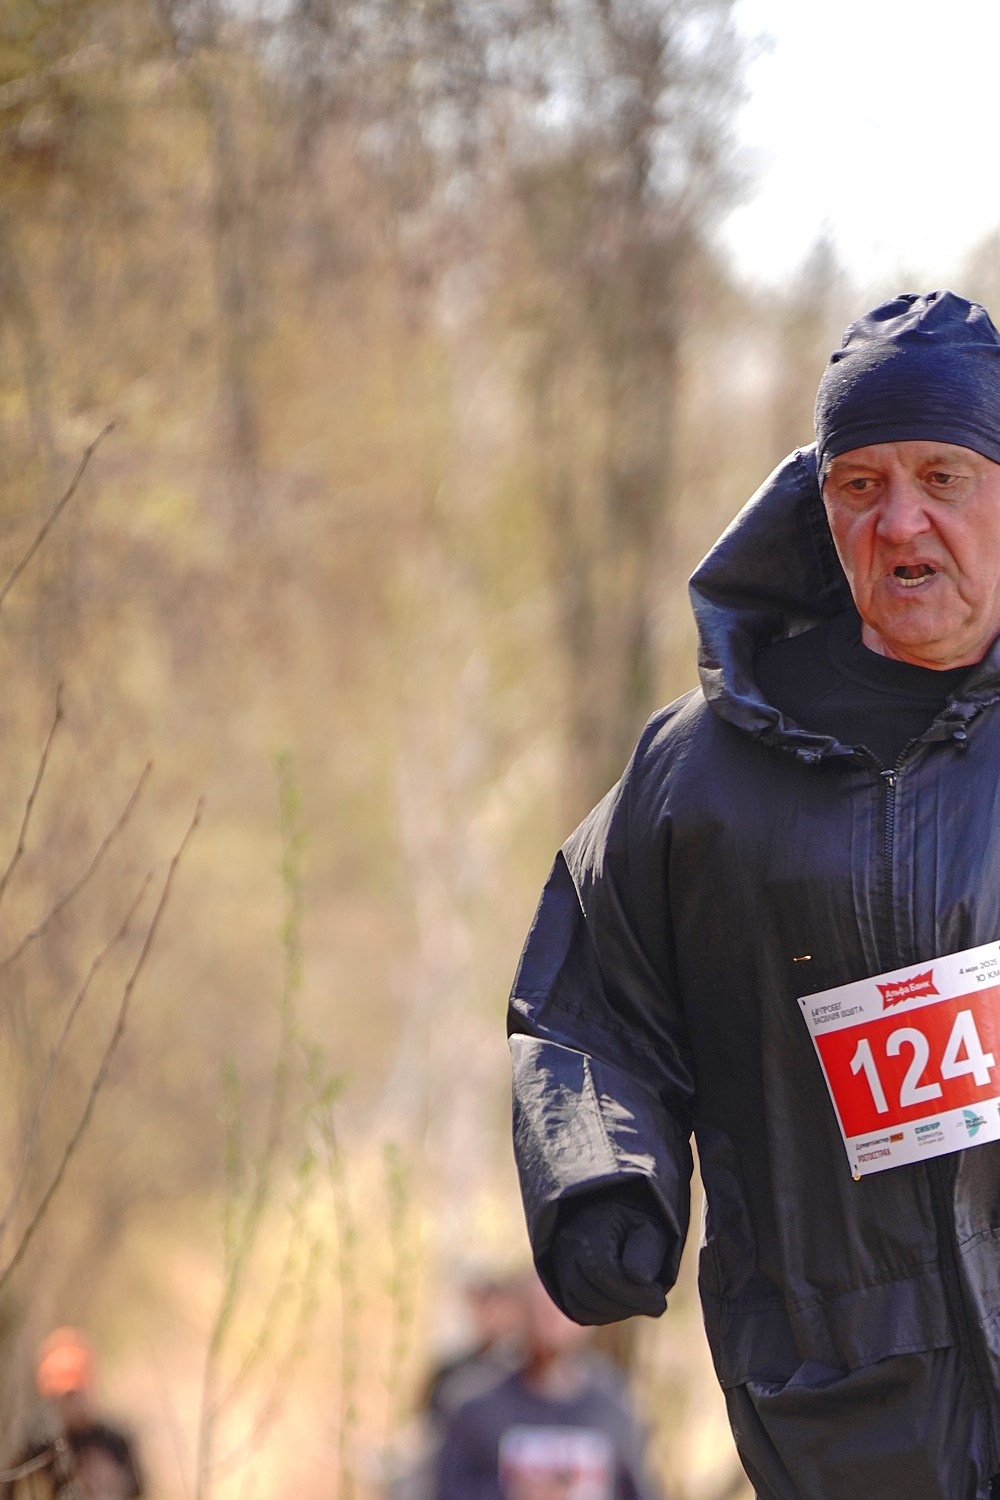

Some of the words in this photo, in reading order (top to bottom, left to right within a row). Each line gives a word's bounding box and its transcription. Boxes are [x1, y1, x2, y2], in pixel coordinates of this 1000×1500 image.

[979, 958, 998, 969] 2025
[976, 973, 986, 983] 10
[849, 1009, 996, 1114] 124
